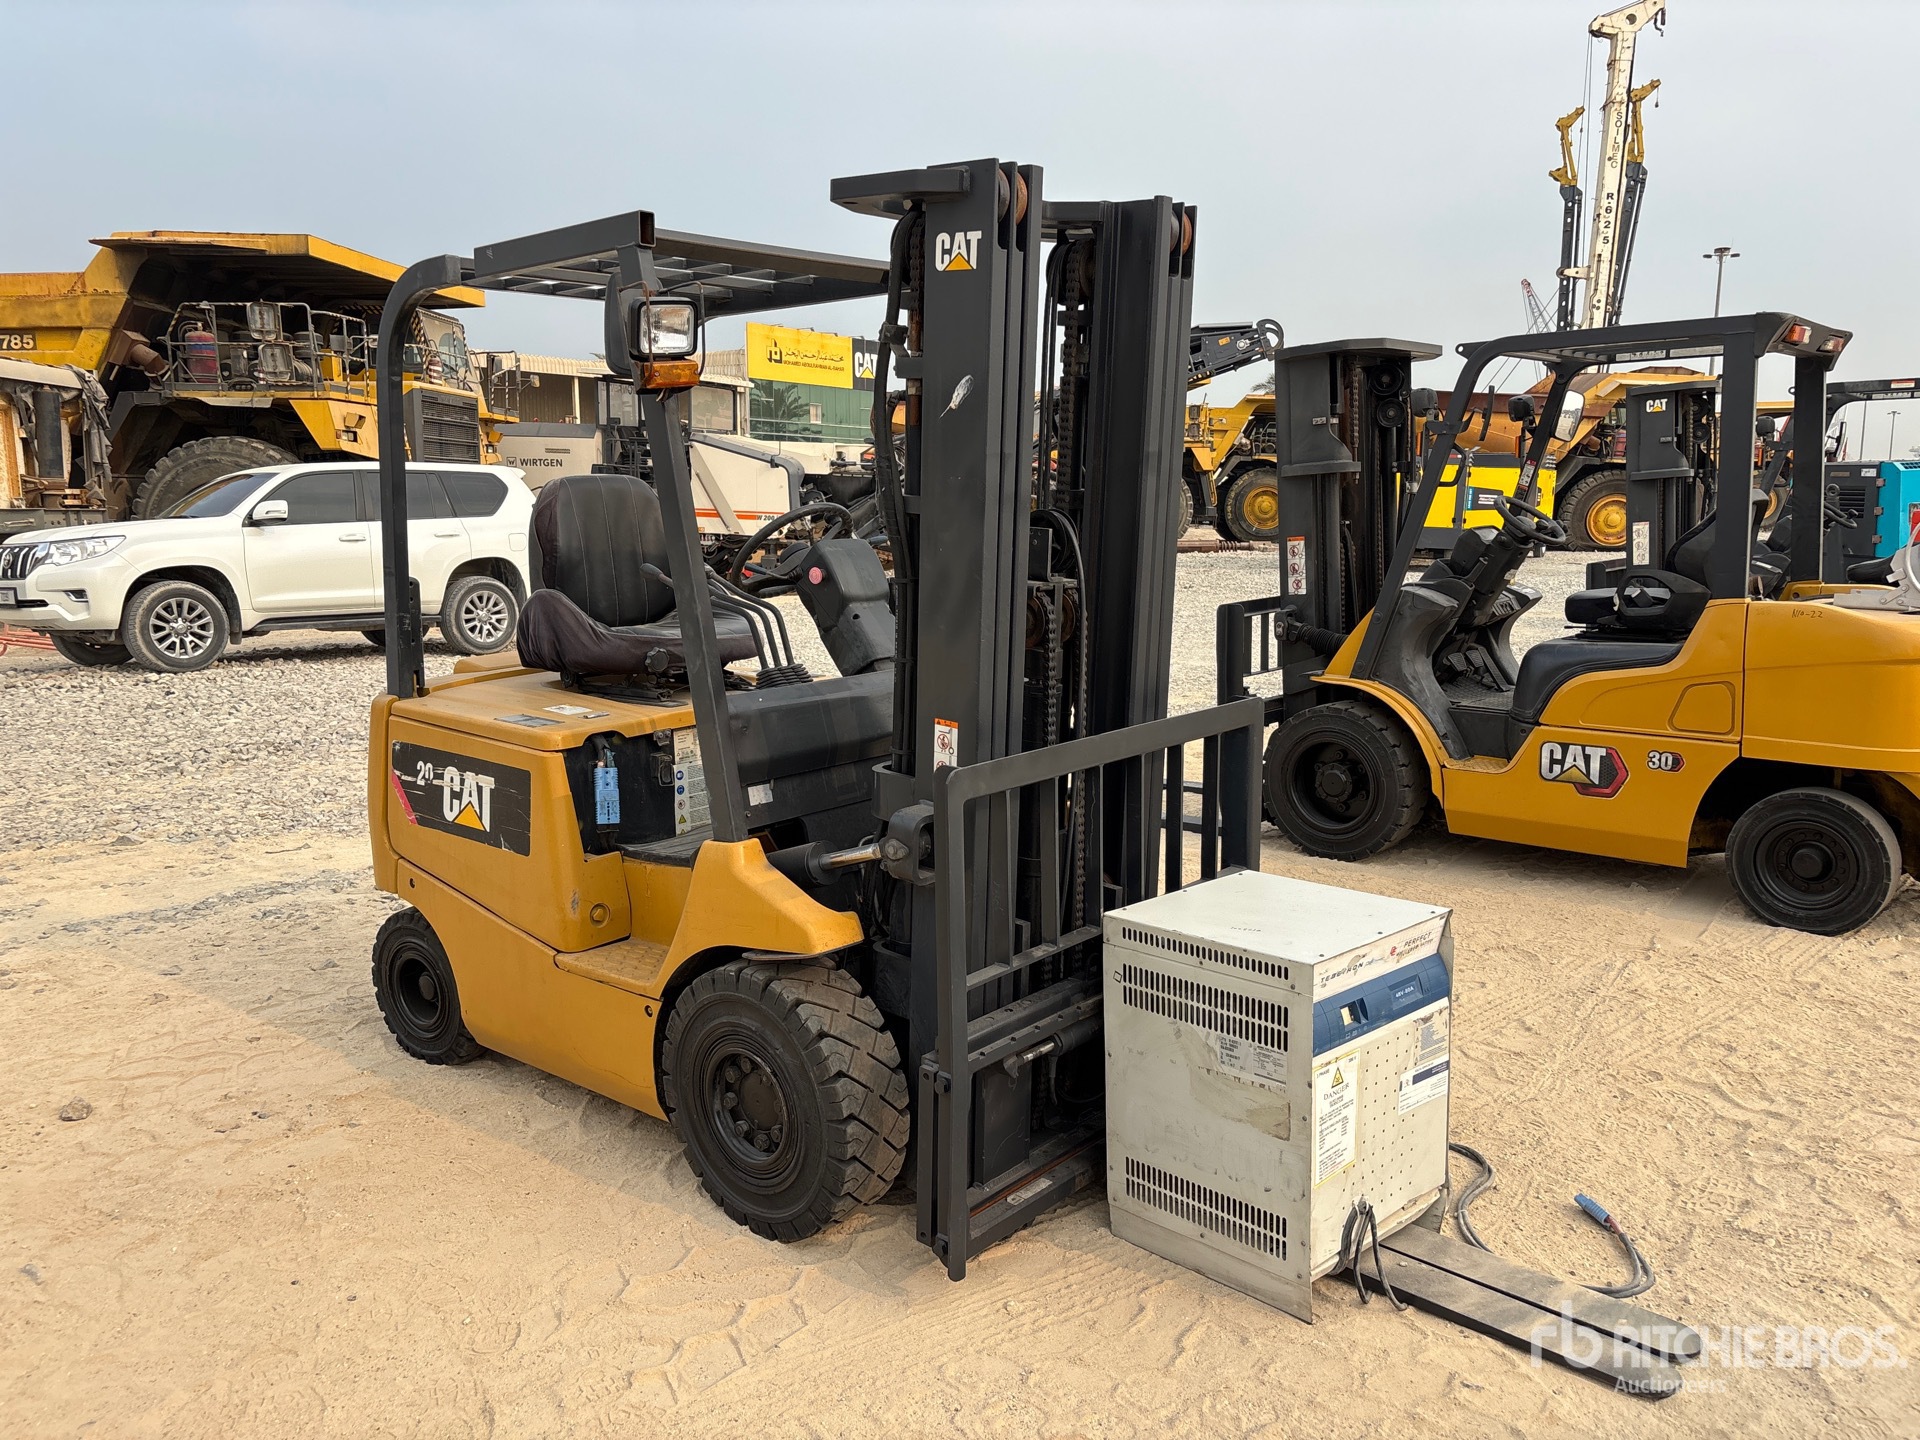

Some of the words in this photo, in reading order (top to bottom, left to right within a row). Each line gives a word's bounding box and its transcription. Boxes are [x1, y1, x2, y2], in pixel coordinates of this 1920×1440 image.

[935, 230, 982, 271] CAT
[0, 334, 34, 350] 785
[855, 352, 878, 378] CAT
[1646, 398, 1668, 413] CAT
[520, 458, 563, 468] WIRTGEN
[1541, 742, 1607, 785] CAT
[1648, 751, 1673, 771] 30
[443, 766, 495, 833] CAT
[1323, 1082, 1350, 1101] DANGER
